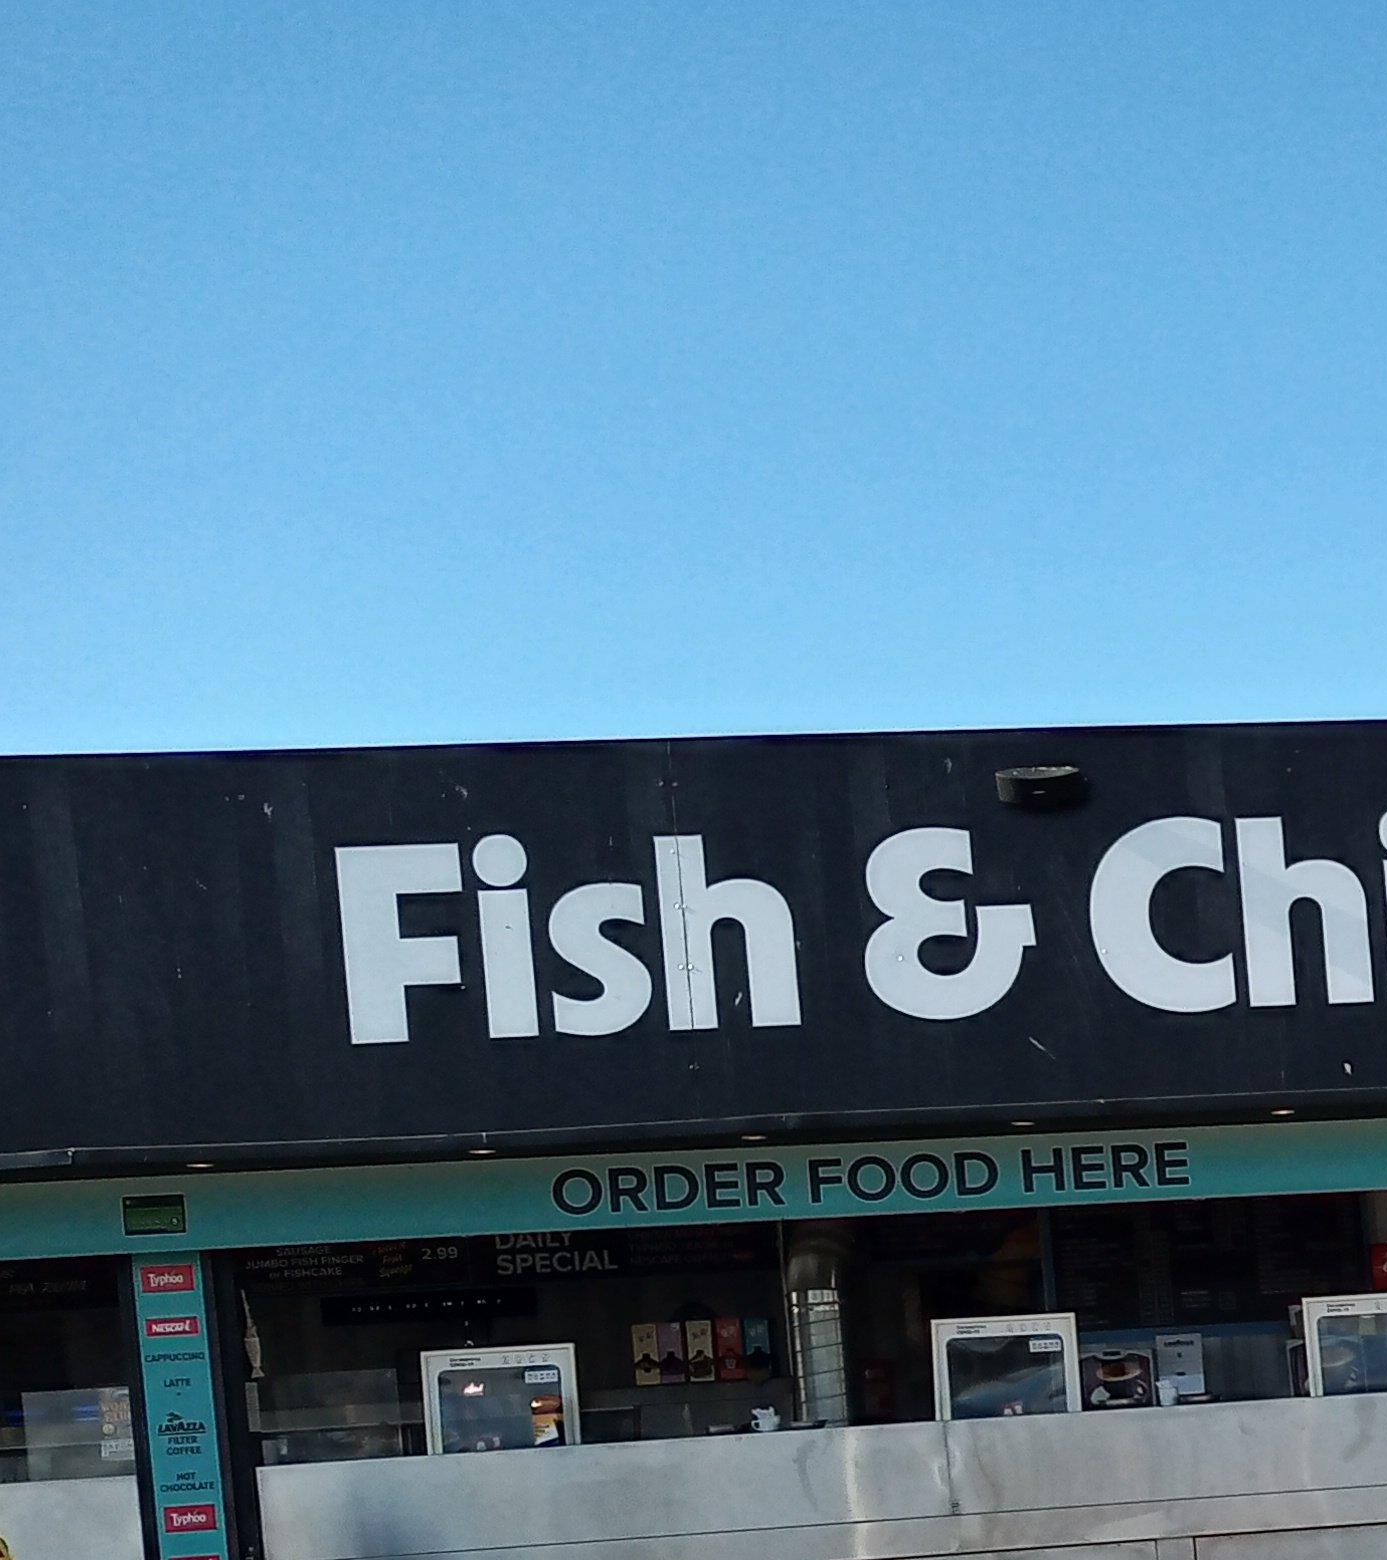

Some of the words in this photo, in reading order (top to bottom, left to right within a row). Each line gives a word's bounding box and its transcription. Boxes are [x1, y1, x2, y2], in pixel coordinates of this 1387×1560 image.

[334, 834, 801, 1044] Fish
[865, 827, 1037, 1020] &
[553, 1158, 785, 1215] ORDER
[808, 1148, 998, 1206] FOOD
[1021, 1140, 1191, 1195] HERE
[422, 1246, 459, 1262] 2.99
[497, 1250, 619, 1275] SPECIAL
[164, 1377, 192, 1388] LATTE
[176, 1472, 197, 1482] HOT
[160, 1481, 216, 1493] CHOCOLATE
[170, 1511, 207, 1527] Typhoo
